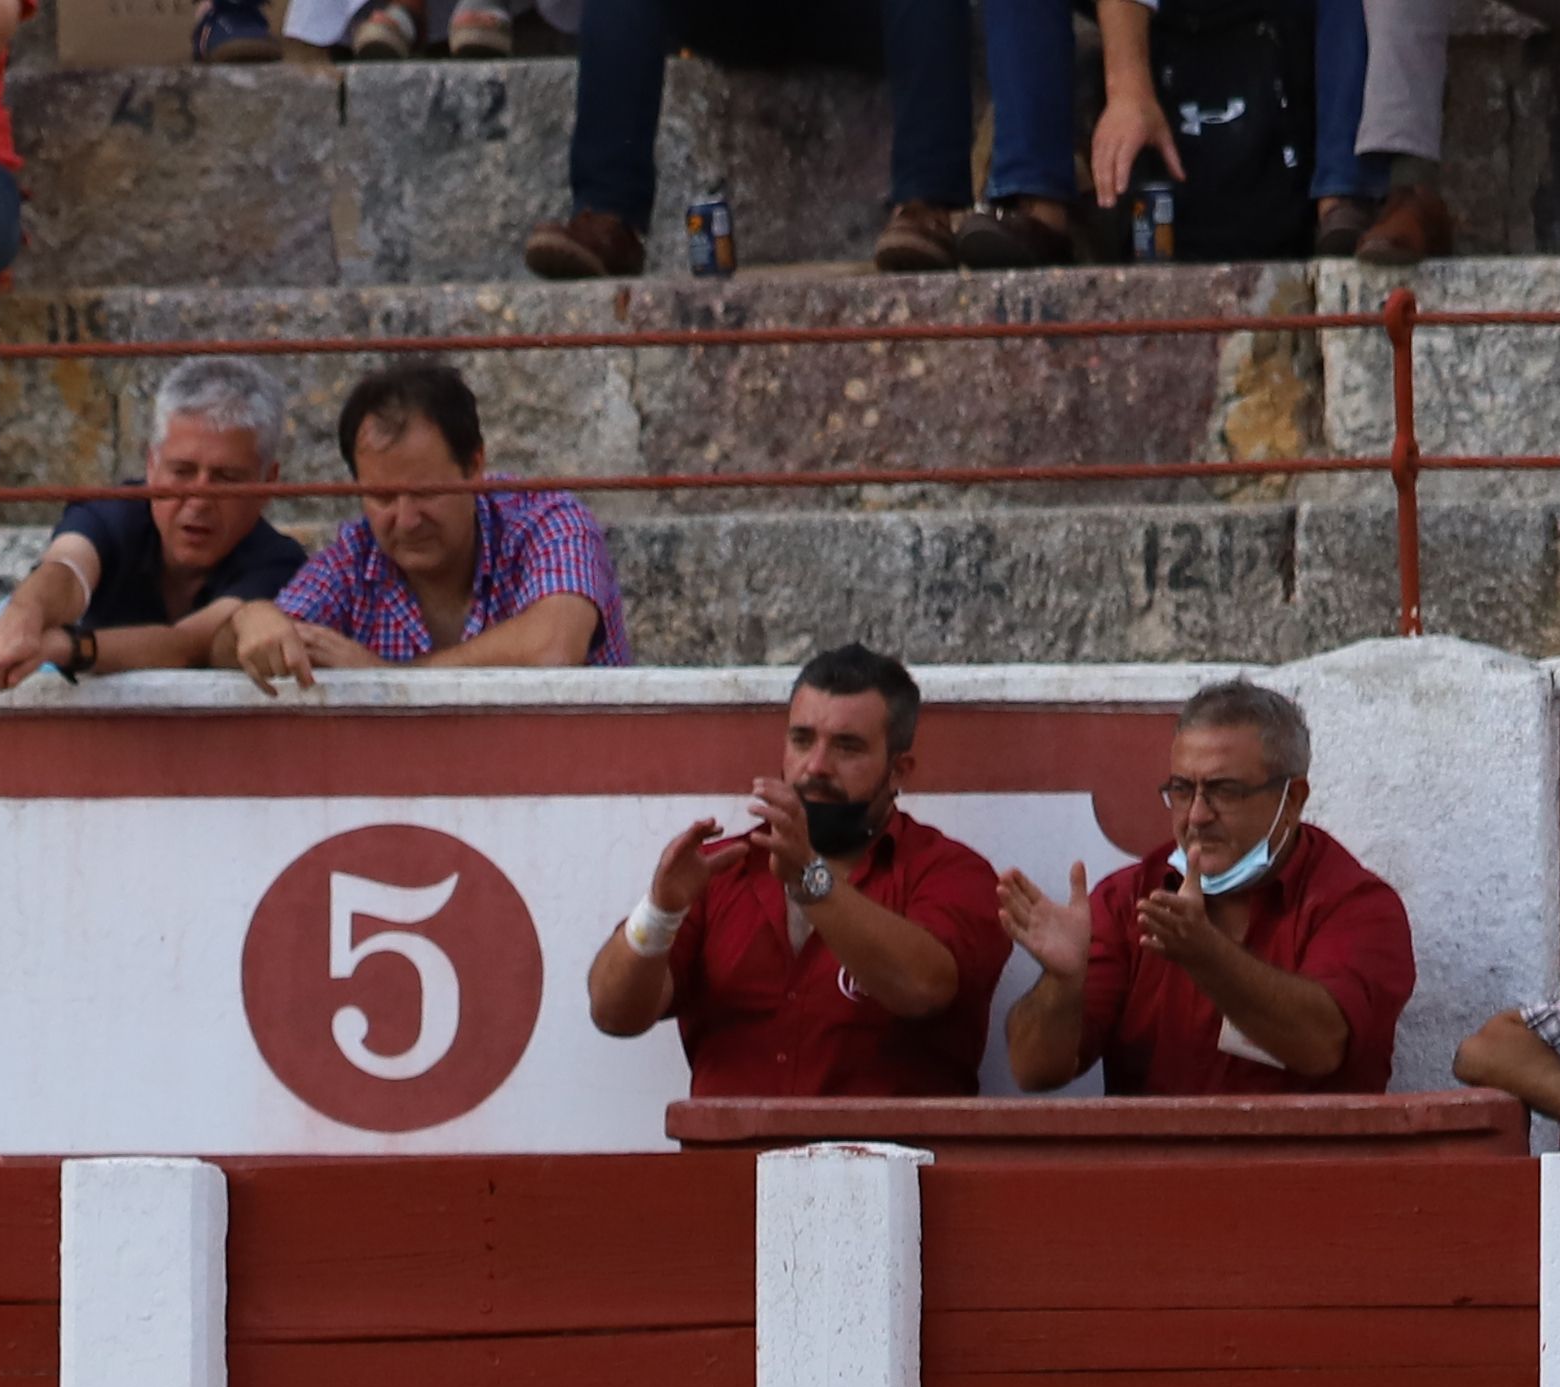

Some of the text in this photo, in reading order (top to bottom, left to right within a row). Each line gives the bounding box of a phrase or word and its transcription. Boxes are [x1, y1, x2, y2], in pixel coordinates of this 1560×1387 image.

[109, 80, 197, 146] 43
[1142, 518, 1234, 596] 121
[329, 870, 461, 1081] 5
